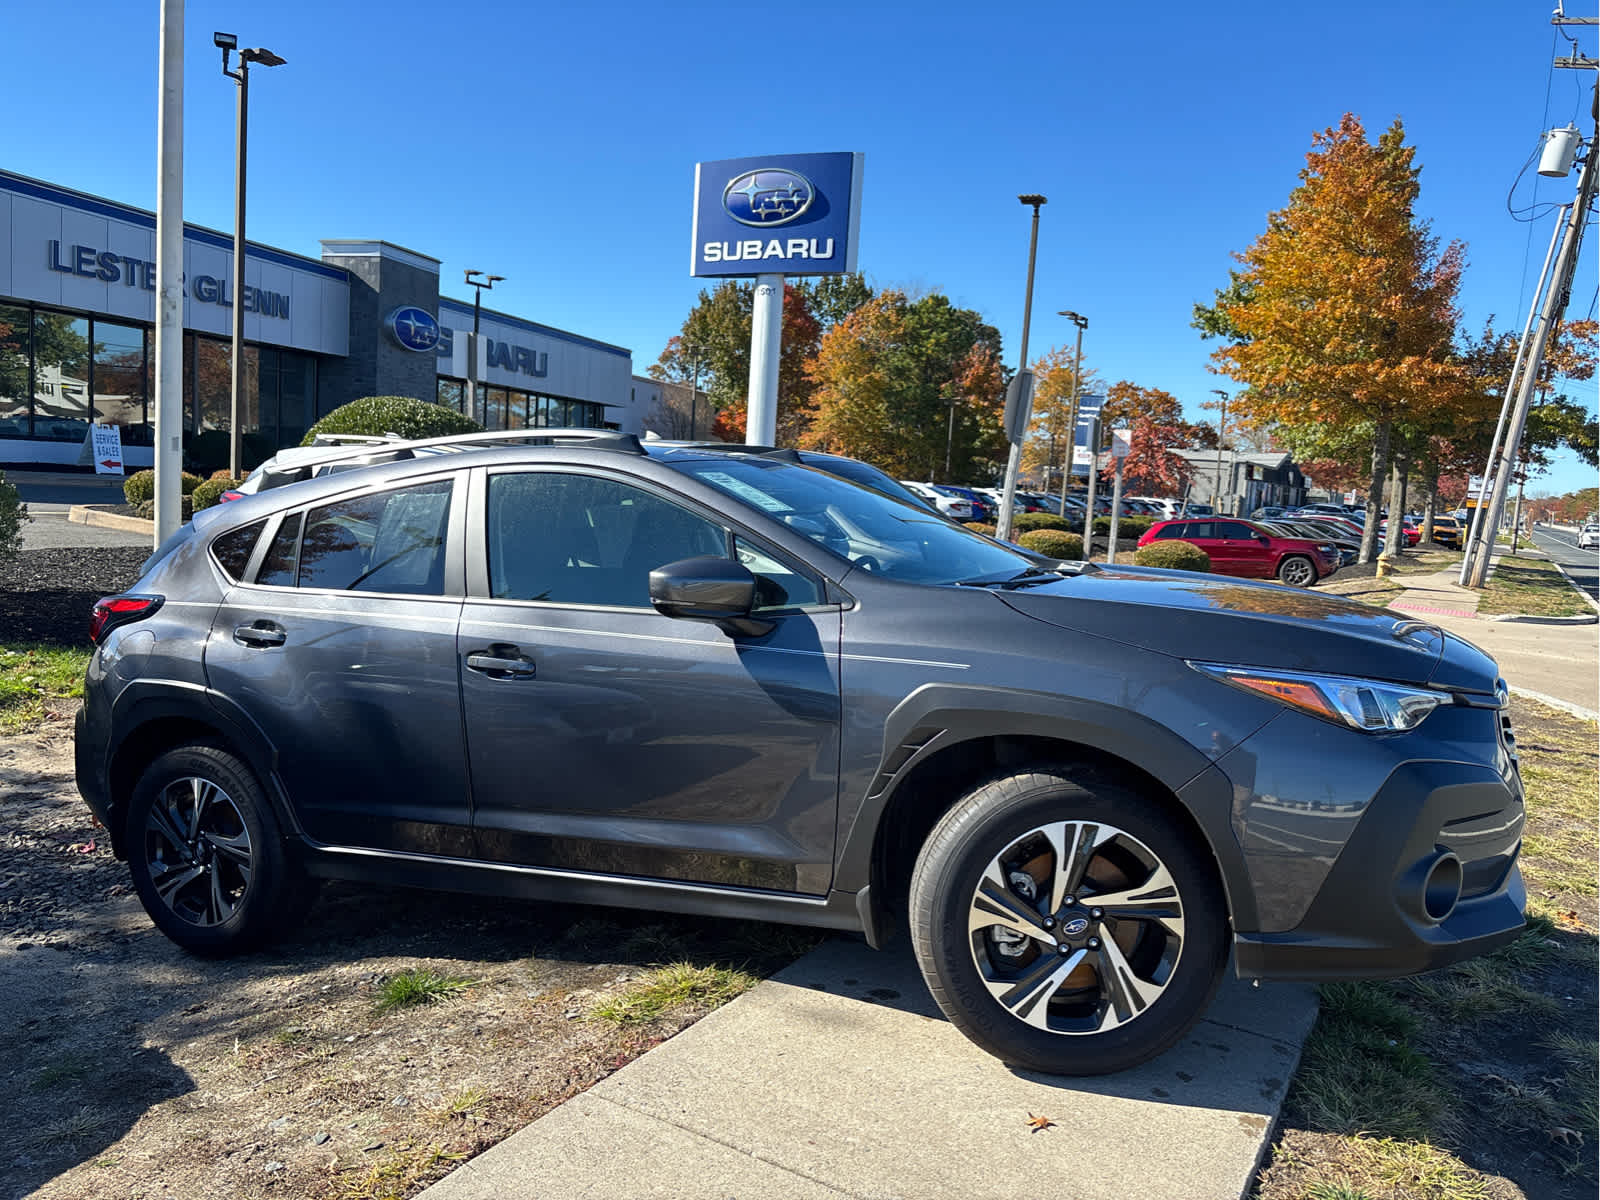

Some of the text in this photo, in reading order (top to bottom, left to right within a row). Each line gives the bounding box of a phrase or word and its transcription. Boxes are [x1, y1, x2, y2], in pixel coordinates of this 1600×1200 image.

[703, 238, 833, 262] SUBARU
[49, 240, 188, 298] LESTE
[436, 327, 548, 377] SARU
[95, 433, 119, 445] SERVICE
[102, 446, 119, 457] SALES
